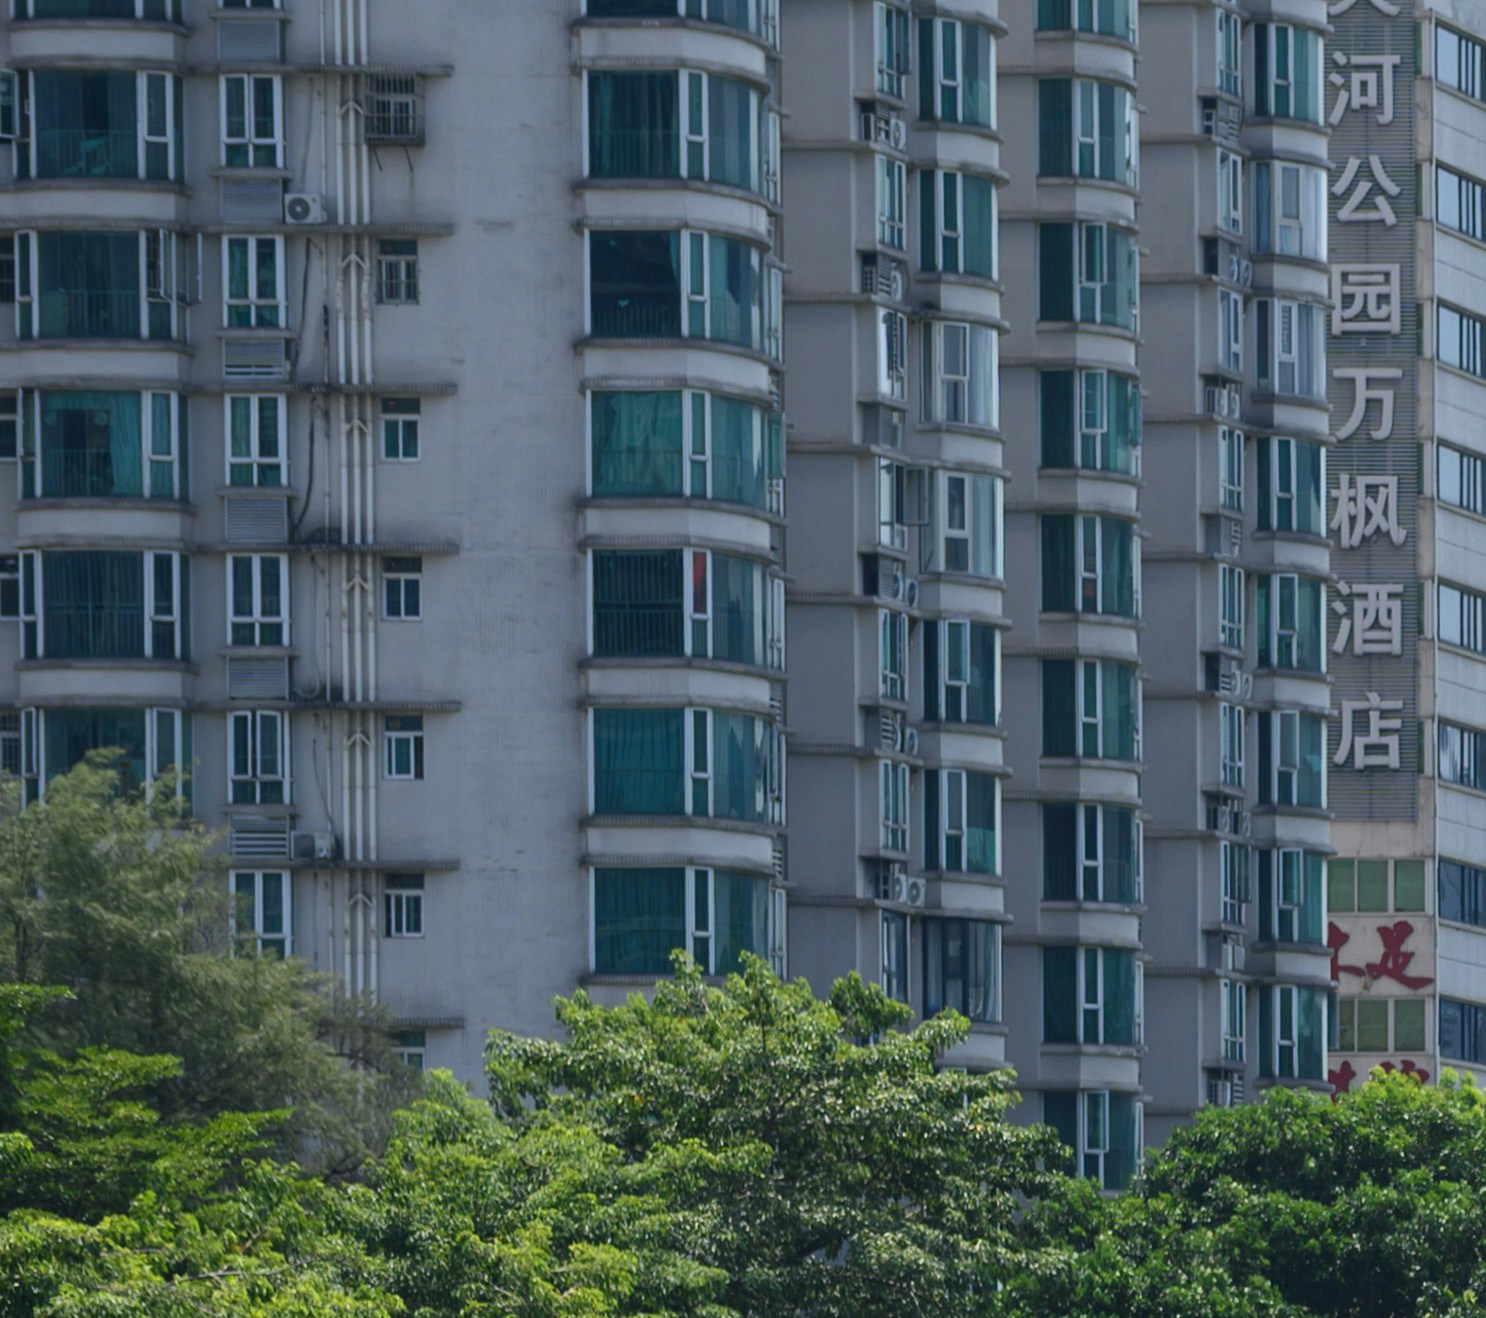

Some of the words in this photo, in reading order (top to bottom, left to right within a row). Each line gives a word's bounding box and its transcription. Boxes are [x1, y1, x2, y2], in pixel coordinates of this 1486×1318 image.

[1328, 0, 1407, 771] 河公园万枫酒店
